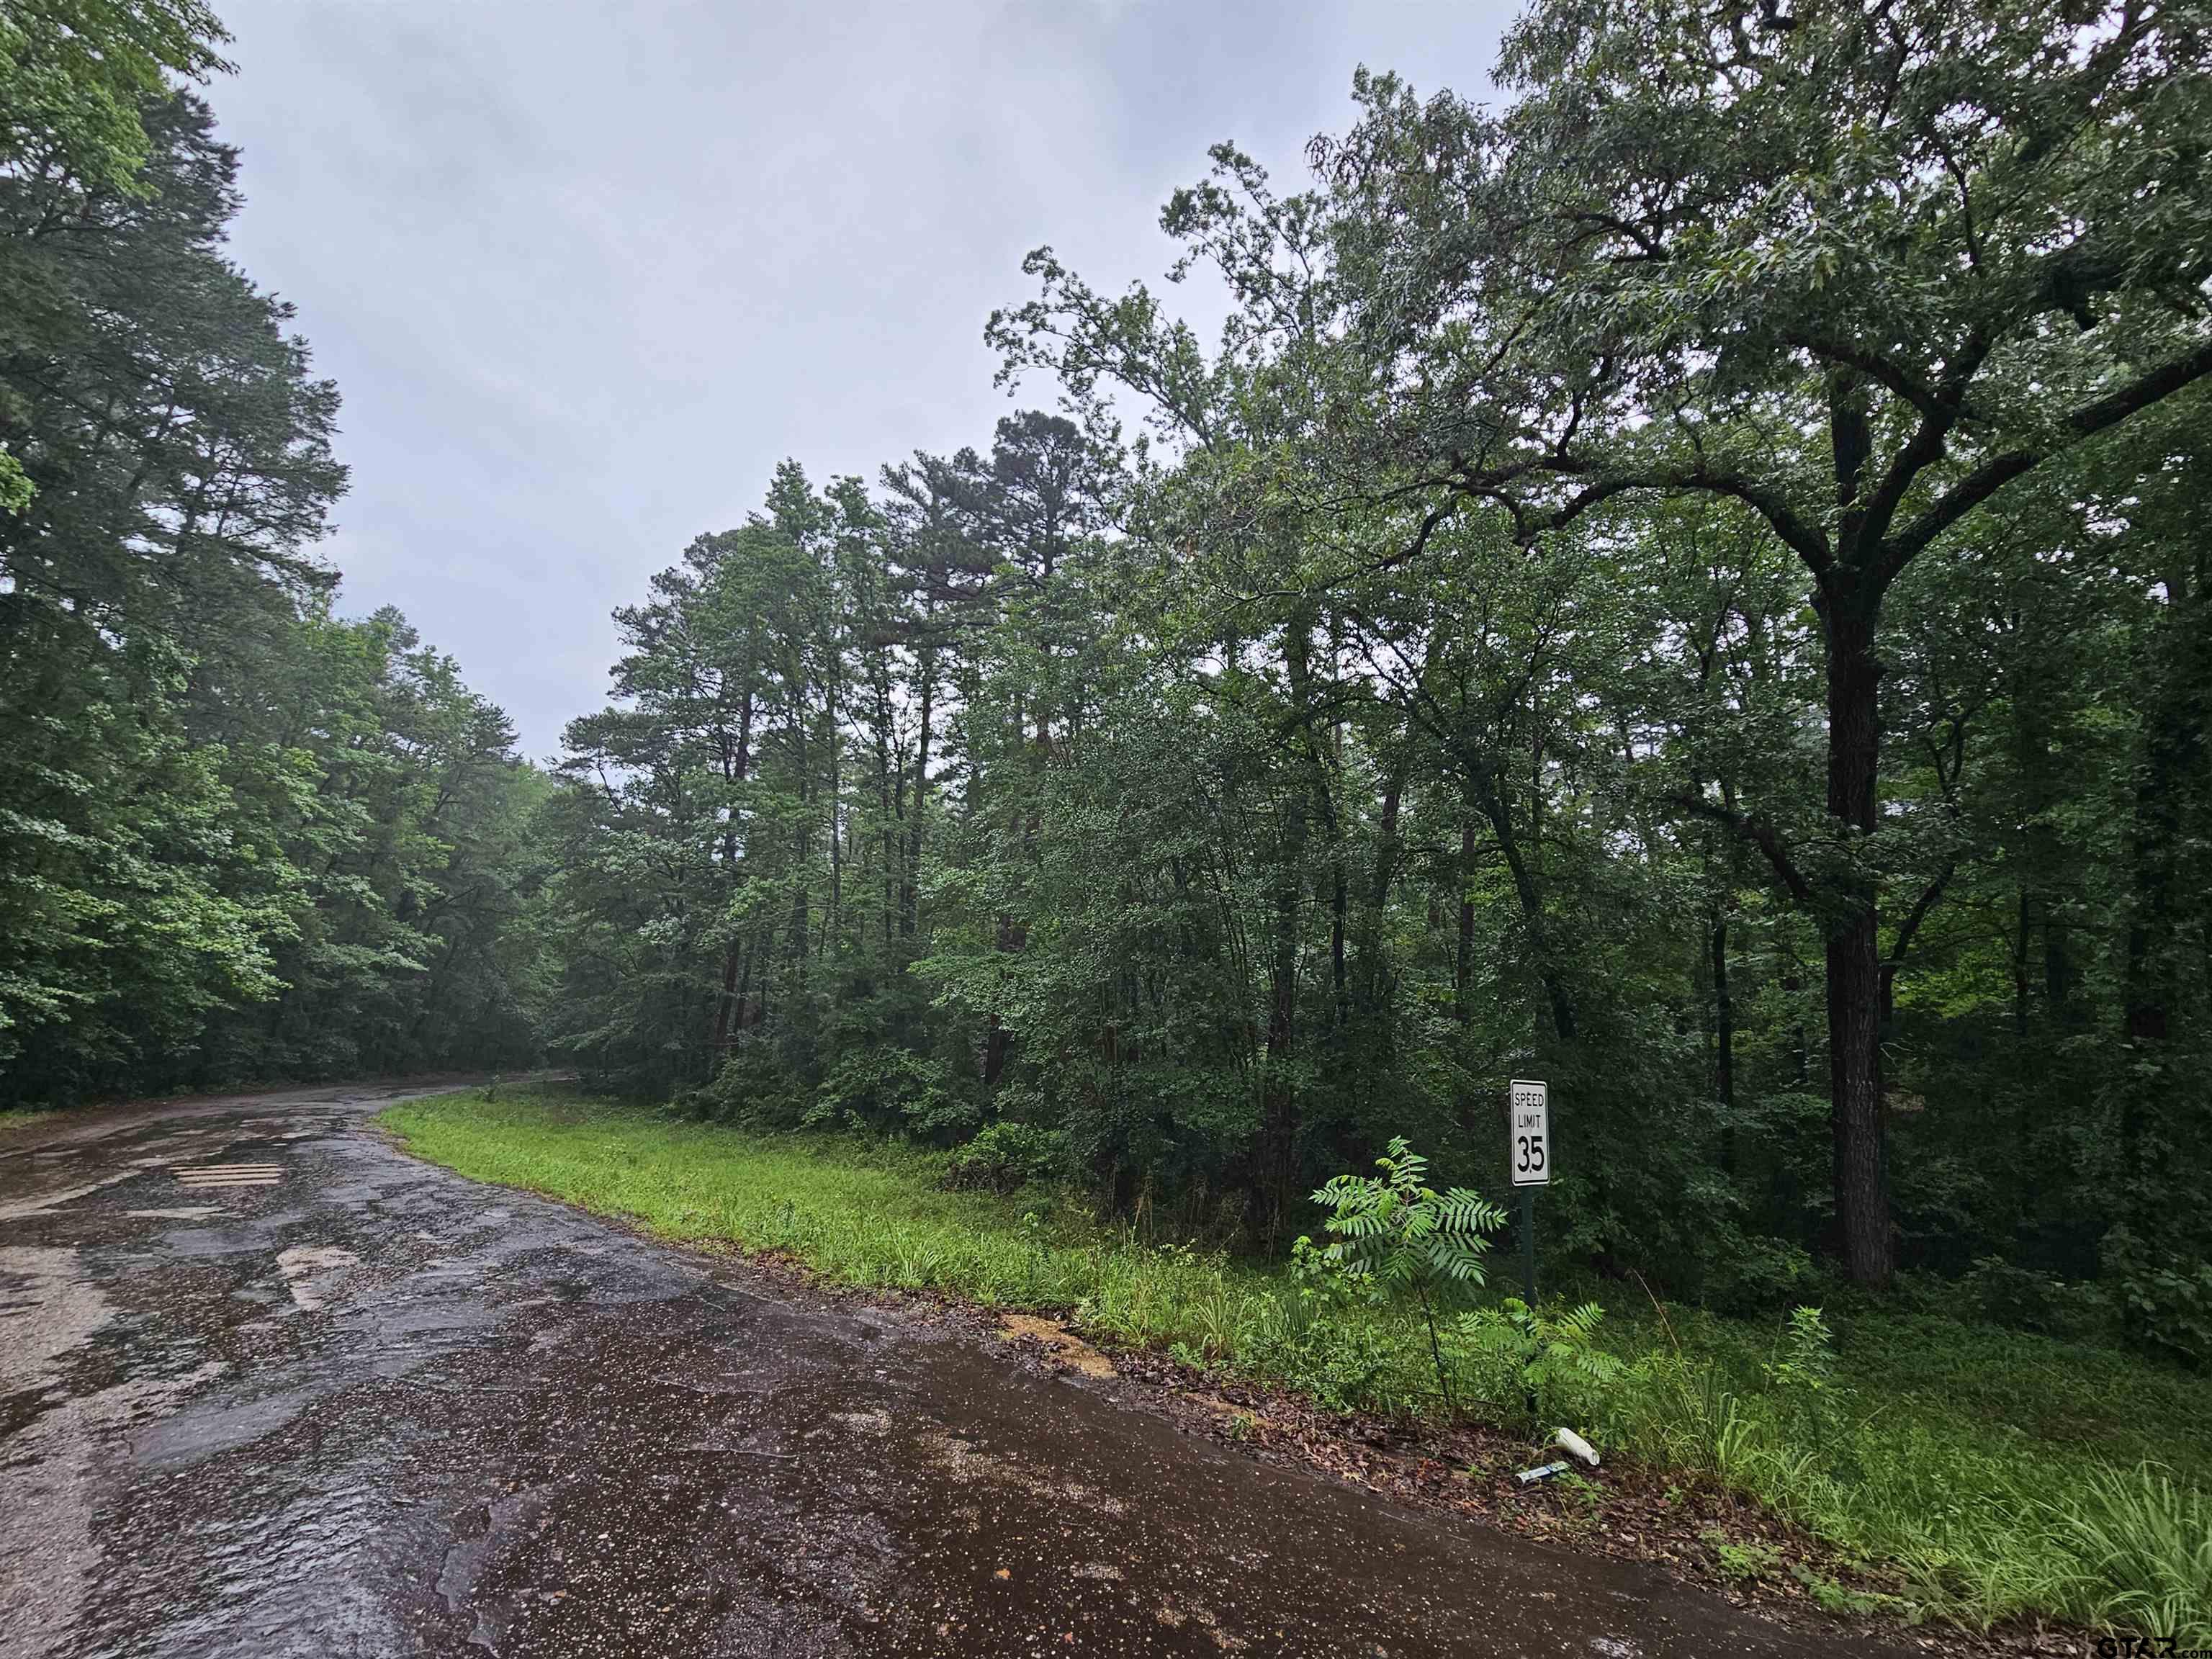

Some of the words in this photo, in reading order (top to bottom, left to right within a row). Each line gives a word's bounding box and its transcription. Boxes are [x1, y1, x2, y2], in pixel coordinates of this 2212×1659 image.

[1515, 1092, 1544, 1107] SPEED
[1518, 1115, 1541, 1128] LIMIT
[1517, 1136, 1545, 1172] 35
